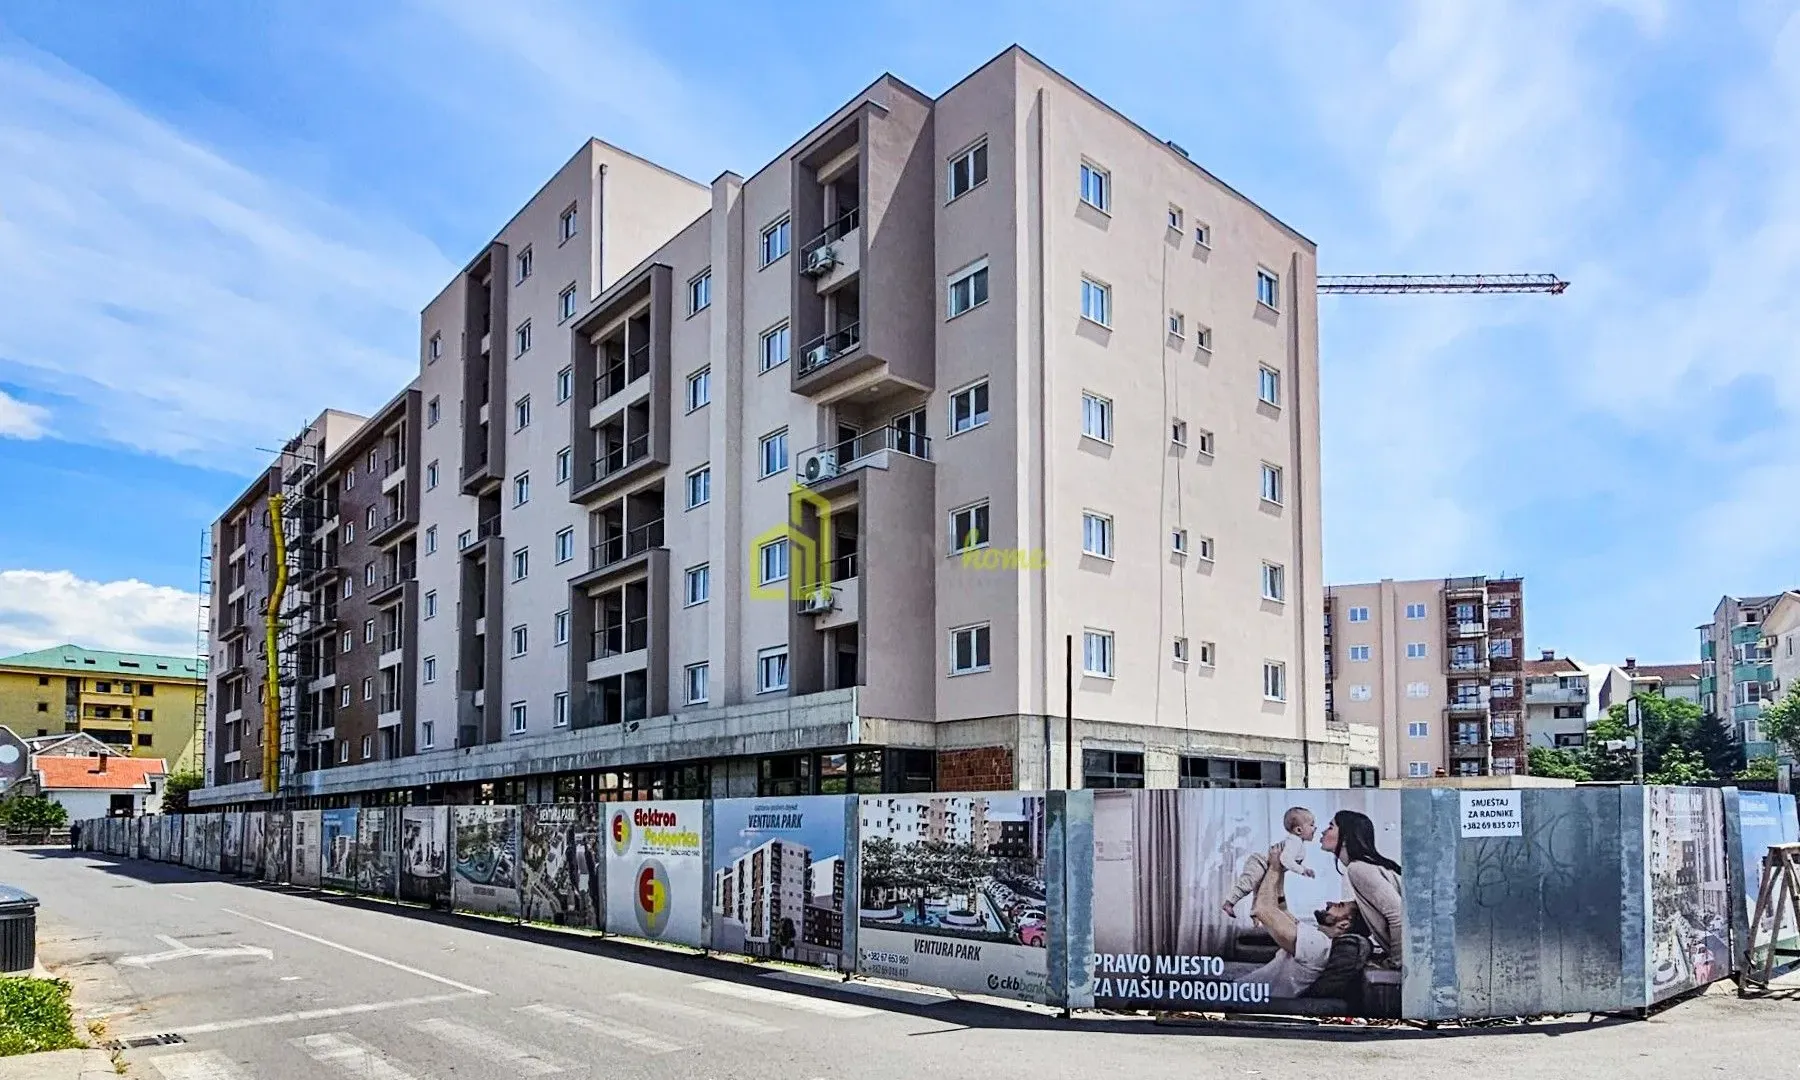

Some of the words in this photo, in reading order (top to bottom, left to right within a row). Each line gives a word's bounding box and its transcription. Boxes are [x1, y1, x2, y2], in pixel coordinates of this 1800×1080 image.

[1471, 798, 1509, 807] SMJEŠTAJ
[634, 808, 677, 826] Elektron
[749, 813, 780, 829] VENTURA
[781, 813, 804, 829] PARK
[1463, 822, 1480, 830] +382
[914, 938, 954, 958] VENTURA
[955, 943, 981, 961] PARK
[1094, 953, 1151, 974] PRAVO
[1155, 954, 1225, 976] MJESTO
[1094, 977, 1113, 997] ZA
[1117, 976, 1163, 999] VAŠU
[1169, 980, 1271, 1004] PORODICU!
